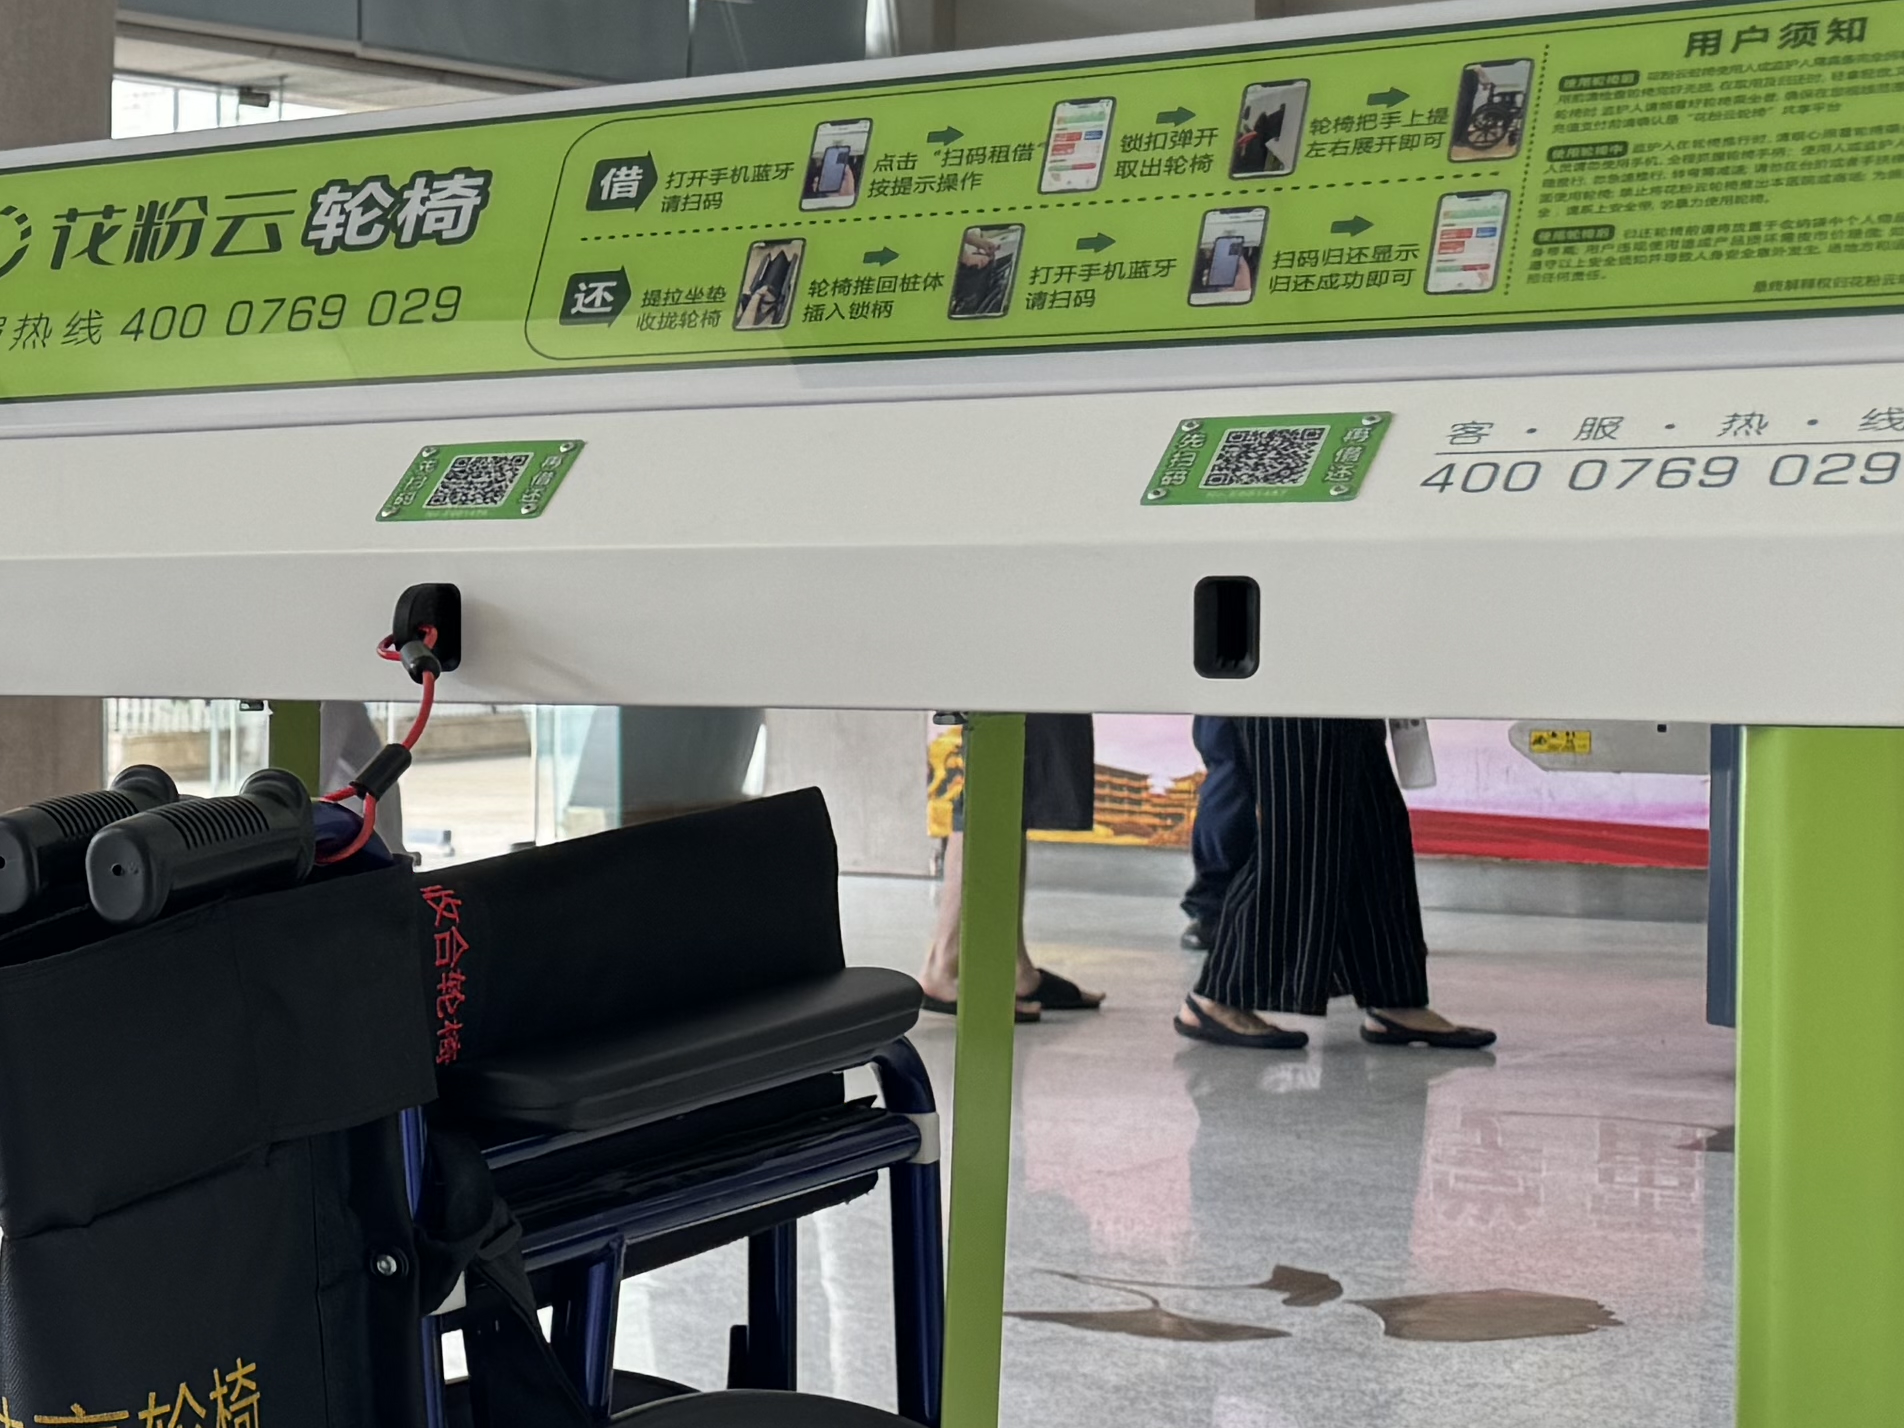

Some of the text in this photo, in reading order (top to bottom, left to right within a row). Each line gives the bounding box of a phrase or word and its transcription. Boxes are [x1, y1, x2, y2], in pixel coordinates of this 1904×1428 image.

[1683, 17, 1869, 58] 用户须知
[1310, 107, 1449, 136] 轮椅把手上提
[1120, 127, 1219, 152] 锁扣弹开
[1305, 132, 1446, 159] 左右展开即可
[665, 161, 795, 189] 打开手机蓝牙
[872, 152, 918, 173] 点击
[1114, 154, 1213, 179] 取出轮椅
[599, 166, 644, 202] 借
[867, 173, 984, 199] 按提示操作
[660, 191, 723, 213] 请扫码
[50, 168, 493, 270] 花粉云轮椅
[1272, 243, 1421, 269] 扫码归还显示
[1030, 258, 1177, 286] 打开手机蓝牙
[1269, 268, 1418, 294] 归还成功即可
[572, 280, 619, 316] 还
[641, 286, 727, 308] 提拉坐垫
[808, 272, 944, 299] 轮椅推回桩体
[801, 300, 894, 324] 插入锁柄
[1025, 288, 1096, 311] 请扫码
[120, 303, 208, 343] 400
[225, 293, 347, 336] 0769
[367, 286, 463, 324] 029
[635, 310, 722, 332] 收拢轮椅
[1420, 452, 1902, 493] 400 0769 029
